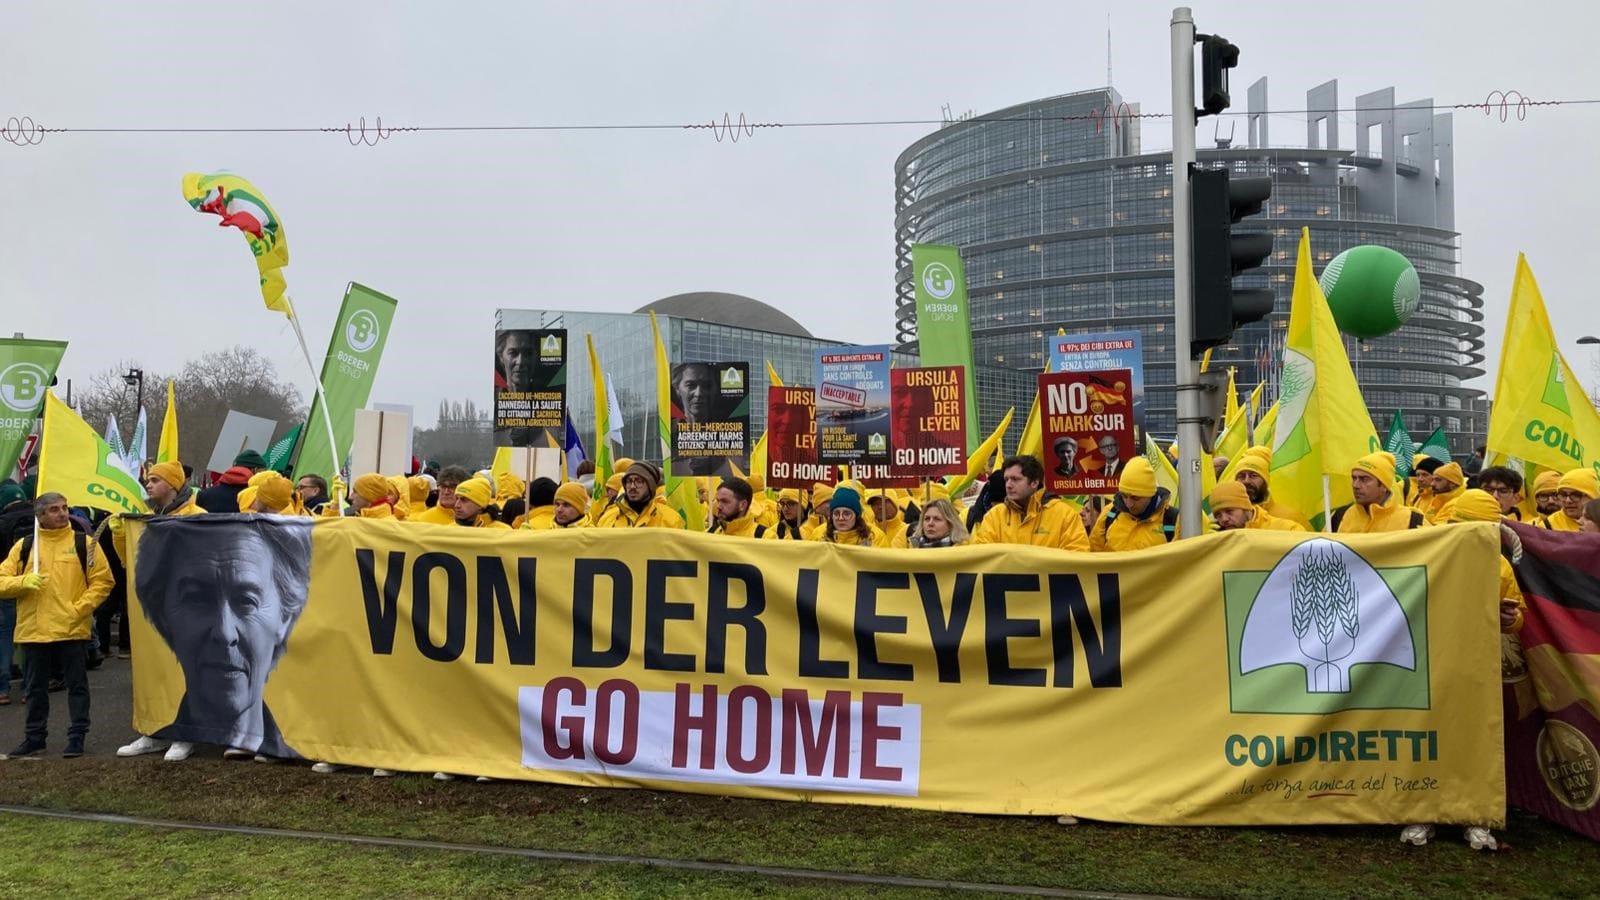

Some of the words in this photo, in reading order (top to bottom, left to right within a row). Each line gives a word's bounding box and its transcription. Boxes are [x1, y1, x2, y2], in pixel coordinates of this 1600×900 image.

[1067, 344, 1079, 352] 97%
[1081, 343, 1090, 351] DEI
[1092, 342, 1104, 350] CIBI
[1105, 341, 1123, 350] EXTRA
[338, 350, 370, 372] BOEREN
[1060, 360, 1082, 370] SENZA
[1084, 358, 1122, 369] CONTROLLI
[823, 372, 838, 380] SANS
[906, 370, 958, 386] URSULA
[526, 392, 562, 400] UE-MERCOSUR
[823, 386, 861, 402] INACCEPTABLE
[932, 386, 959, 401] VON
[1047, 382, 1088, 415] NO
[498, 401, 531, 410] DANNEGGIA
[532, 401, 540, 409] LA
[540, 401, 562, 409] SALUTE
[934, 401, 959, 416] DER
[498, 410, 506, 418] DEI
[507, 410, 531, 418] CITTADINI
[536, 410, 562, 418] SACRIFICA
[526, 418, 561, 426] AGRICOLTURA
[677, 422, 691, 431] THE
[692, 422, 743, 431] EU-MERCOSUR
[920, 416, 960, 432] LEYEN
[1049, 413, 1125, 433] MARKSUR
[5, 430, 25, 440] BON
[678, 431, 717, 441] AGREEMENT
[719, 431, 743, 441] HARMS
[795, 434, 816, 448] LEY
[835, 433, 841, 441] LA
[678, 441, 706, 449] CITIZENS'
[707, 441, 729, 449] HEALTH
[731, 441, 744, 449] AND
[895, 448, 914, 465] GO
[919, 448, 961, 465] HOME
[772, 461, 789, 478] GO
[793, 463, 832, 481] HOME
[1054, 480, 1083, 490] URSULA
[1084, 477, 1105, 489] ÜBER
[1106, 478, 1119, 488] ALL
[355, 548, 536, 665] VON
[571, 558, 769, 676] DER
[796, 568, 1123, 688] LEYEN
[541, 676, 640, 766] GO
[671, 682, 903, 782] HOME
[1224, 730, 1438, 768] COLDIRETTI
[1260, 777, 1304, 799] forza
[1308, 777, 1355, 791] amica
[1361, 772, 1386, 791] del
[1393, 776, 1440, 792] Paese
